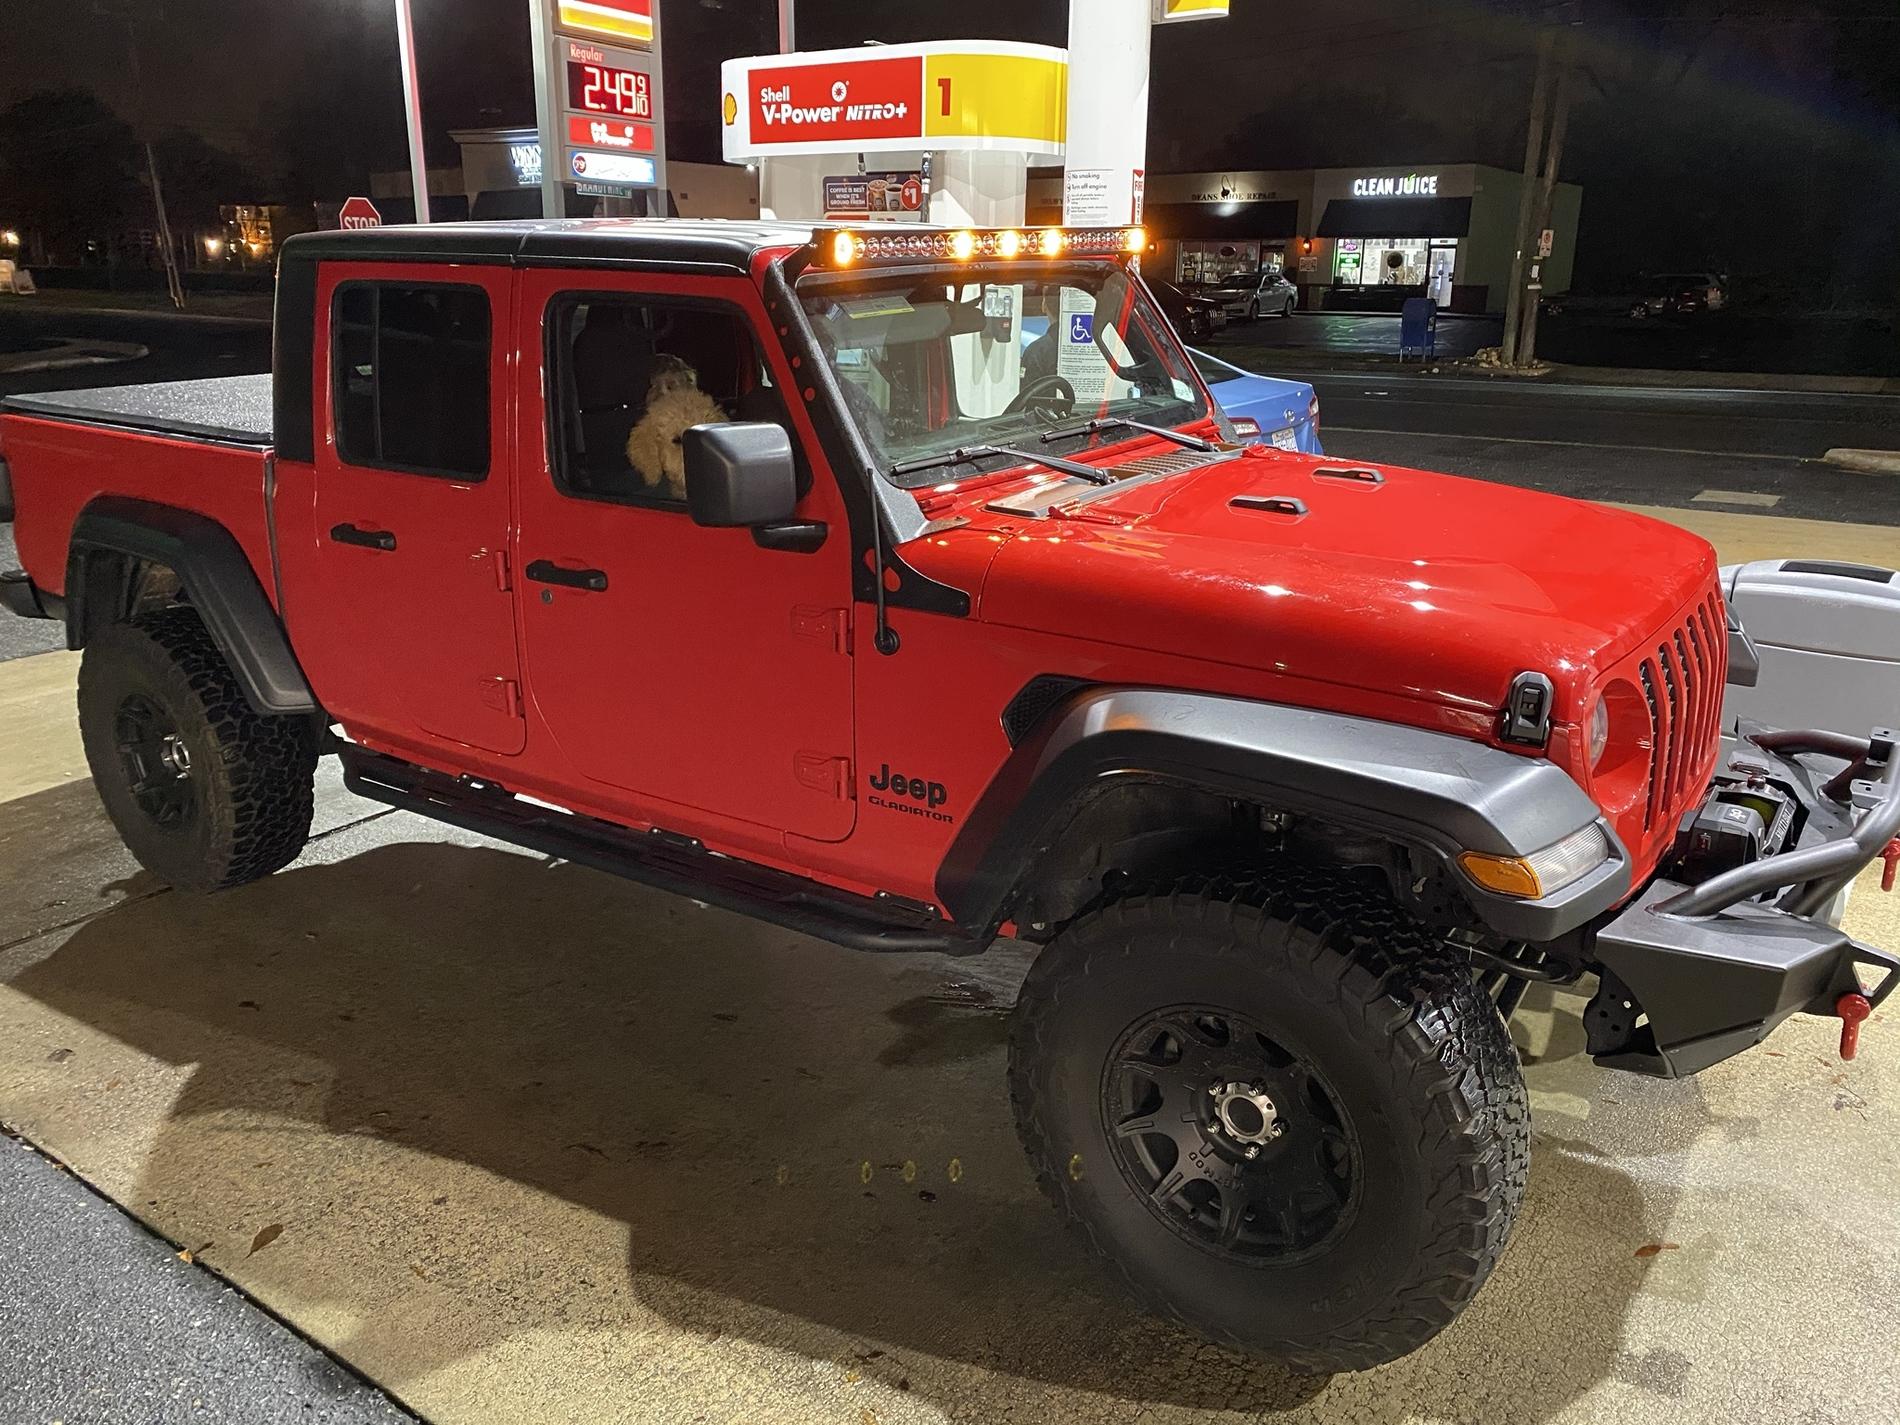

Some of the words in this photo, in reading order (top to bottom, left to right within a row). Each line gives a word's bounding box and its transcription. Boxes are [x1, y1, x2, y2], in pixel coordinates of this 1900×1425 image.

[570, 43, 604, 63] Regular
[584, 66, 637, 114] 2.49
[761, 85, 791, 103] Shell
[937, 78, 951, 116] 1
[762, 103, 841, 126] V-Power
[1078, 172, 1100, 180] smoking
[1354, 178, 1395, 196] CLEAN
[1395, 174, 1438, 196] JUICE
[904, 188, 917, 204] $1
[344, 215, 378, 230] STOP
[869, 764, 947, 809] Jeep
[868, 796, 954, 824] GLADIATOR
